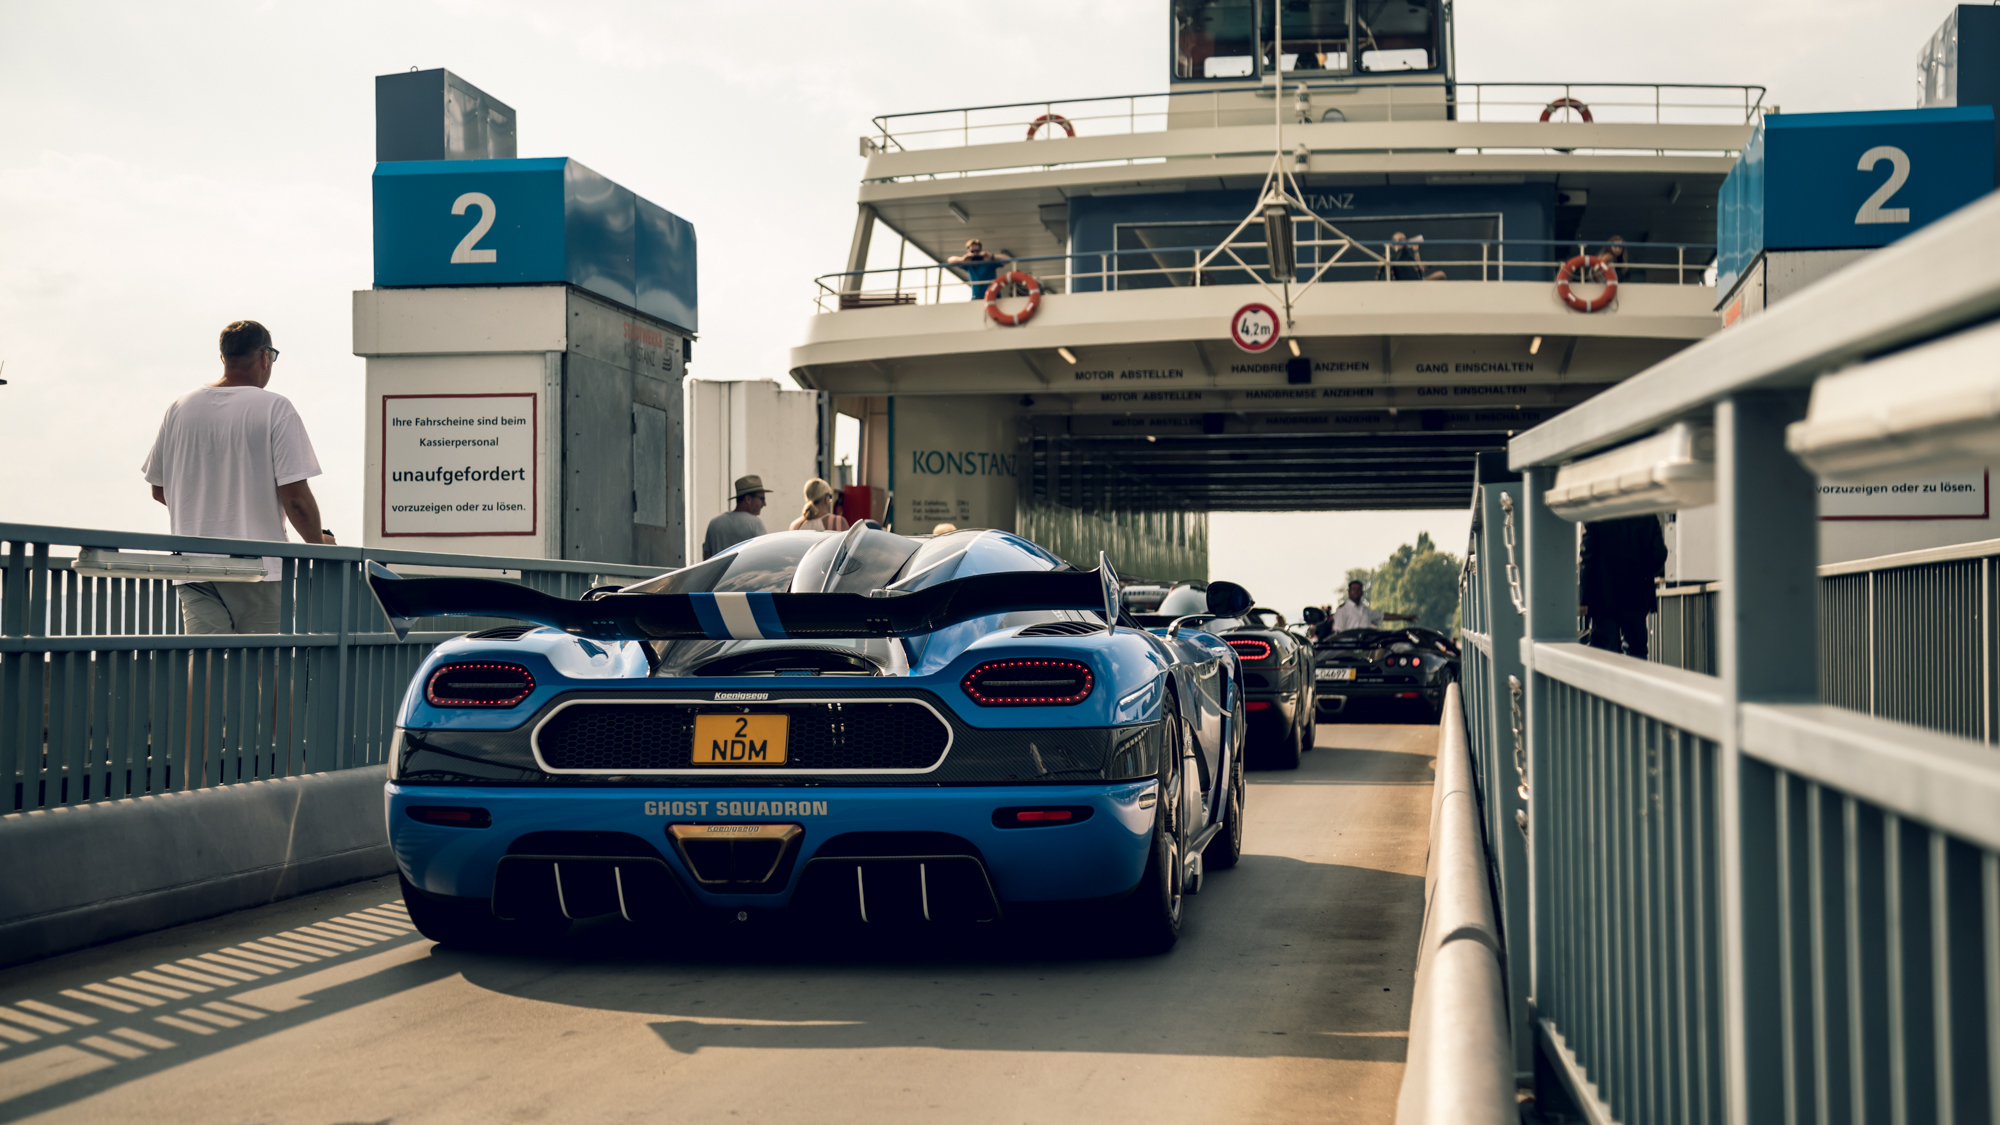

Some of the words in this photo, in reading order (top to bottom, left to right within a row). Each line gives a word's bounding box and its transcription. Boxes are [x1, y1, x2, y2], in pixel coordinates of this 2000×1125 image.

[1854, 145, 1910, 225] 2
[450, 192, 497, 264] 2
[1314, 362, 1369, 372] ANZIEHEN
[1416, 363, 1449, 373] GANG
[1455, 362, 1534, 372] EINSCHALTEN
[1075, 371, 1114, 380] MOTOR
[1120, 369, 1183, 379] ABSTELLEN
[1101, 392, 1138, 401] MOTOR
[1143, 391, 1202, 401] ABSTELLEN
[1246, 390, 1316, 399] HANDBREMSE
[1323, 388, 1374, 398] ANZIEHEN
[1417, 387, 1448, 396] GANG
[1454, 385, 1527, 395] EINSCHALTEN
[392, 418, 412, 427] Ihre
[415, 417, 474, 427] Fahrscheine
[477, 416, 498, 426] sind
[501, 416, 526, 426] beim
[419, 437, 499, 448] Kassierpersonal
[912, 450, 1017, 477] KONSTANZ
[392, 466, 525, 485] unaufgefordert
[1816, 484, 1888, 496] vorzuzeigen
[1891, 483, 1919, 493] oder
[1922, 485, 1937, 493] zu
[1940, 482, 1976, 493] lösen.
[391, 503, 453, 514] vorzuzeigen
[456, 502, 479, 512] oder
[482, 504, 493, 512] zu
[496, 502, 526, 512] lösen.
[714, 692, 769, 700] Koenigsegg
[734, 717, 748, 738] 2
[711, 740, 768, 761] NDM
[644, 801, 709, 816] GHOST
[716, 801, 828, 816] SQUADRON
[706, 825, 760, 833] Koenigsegg
